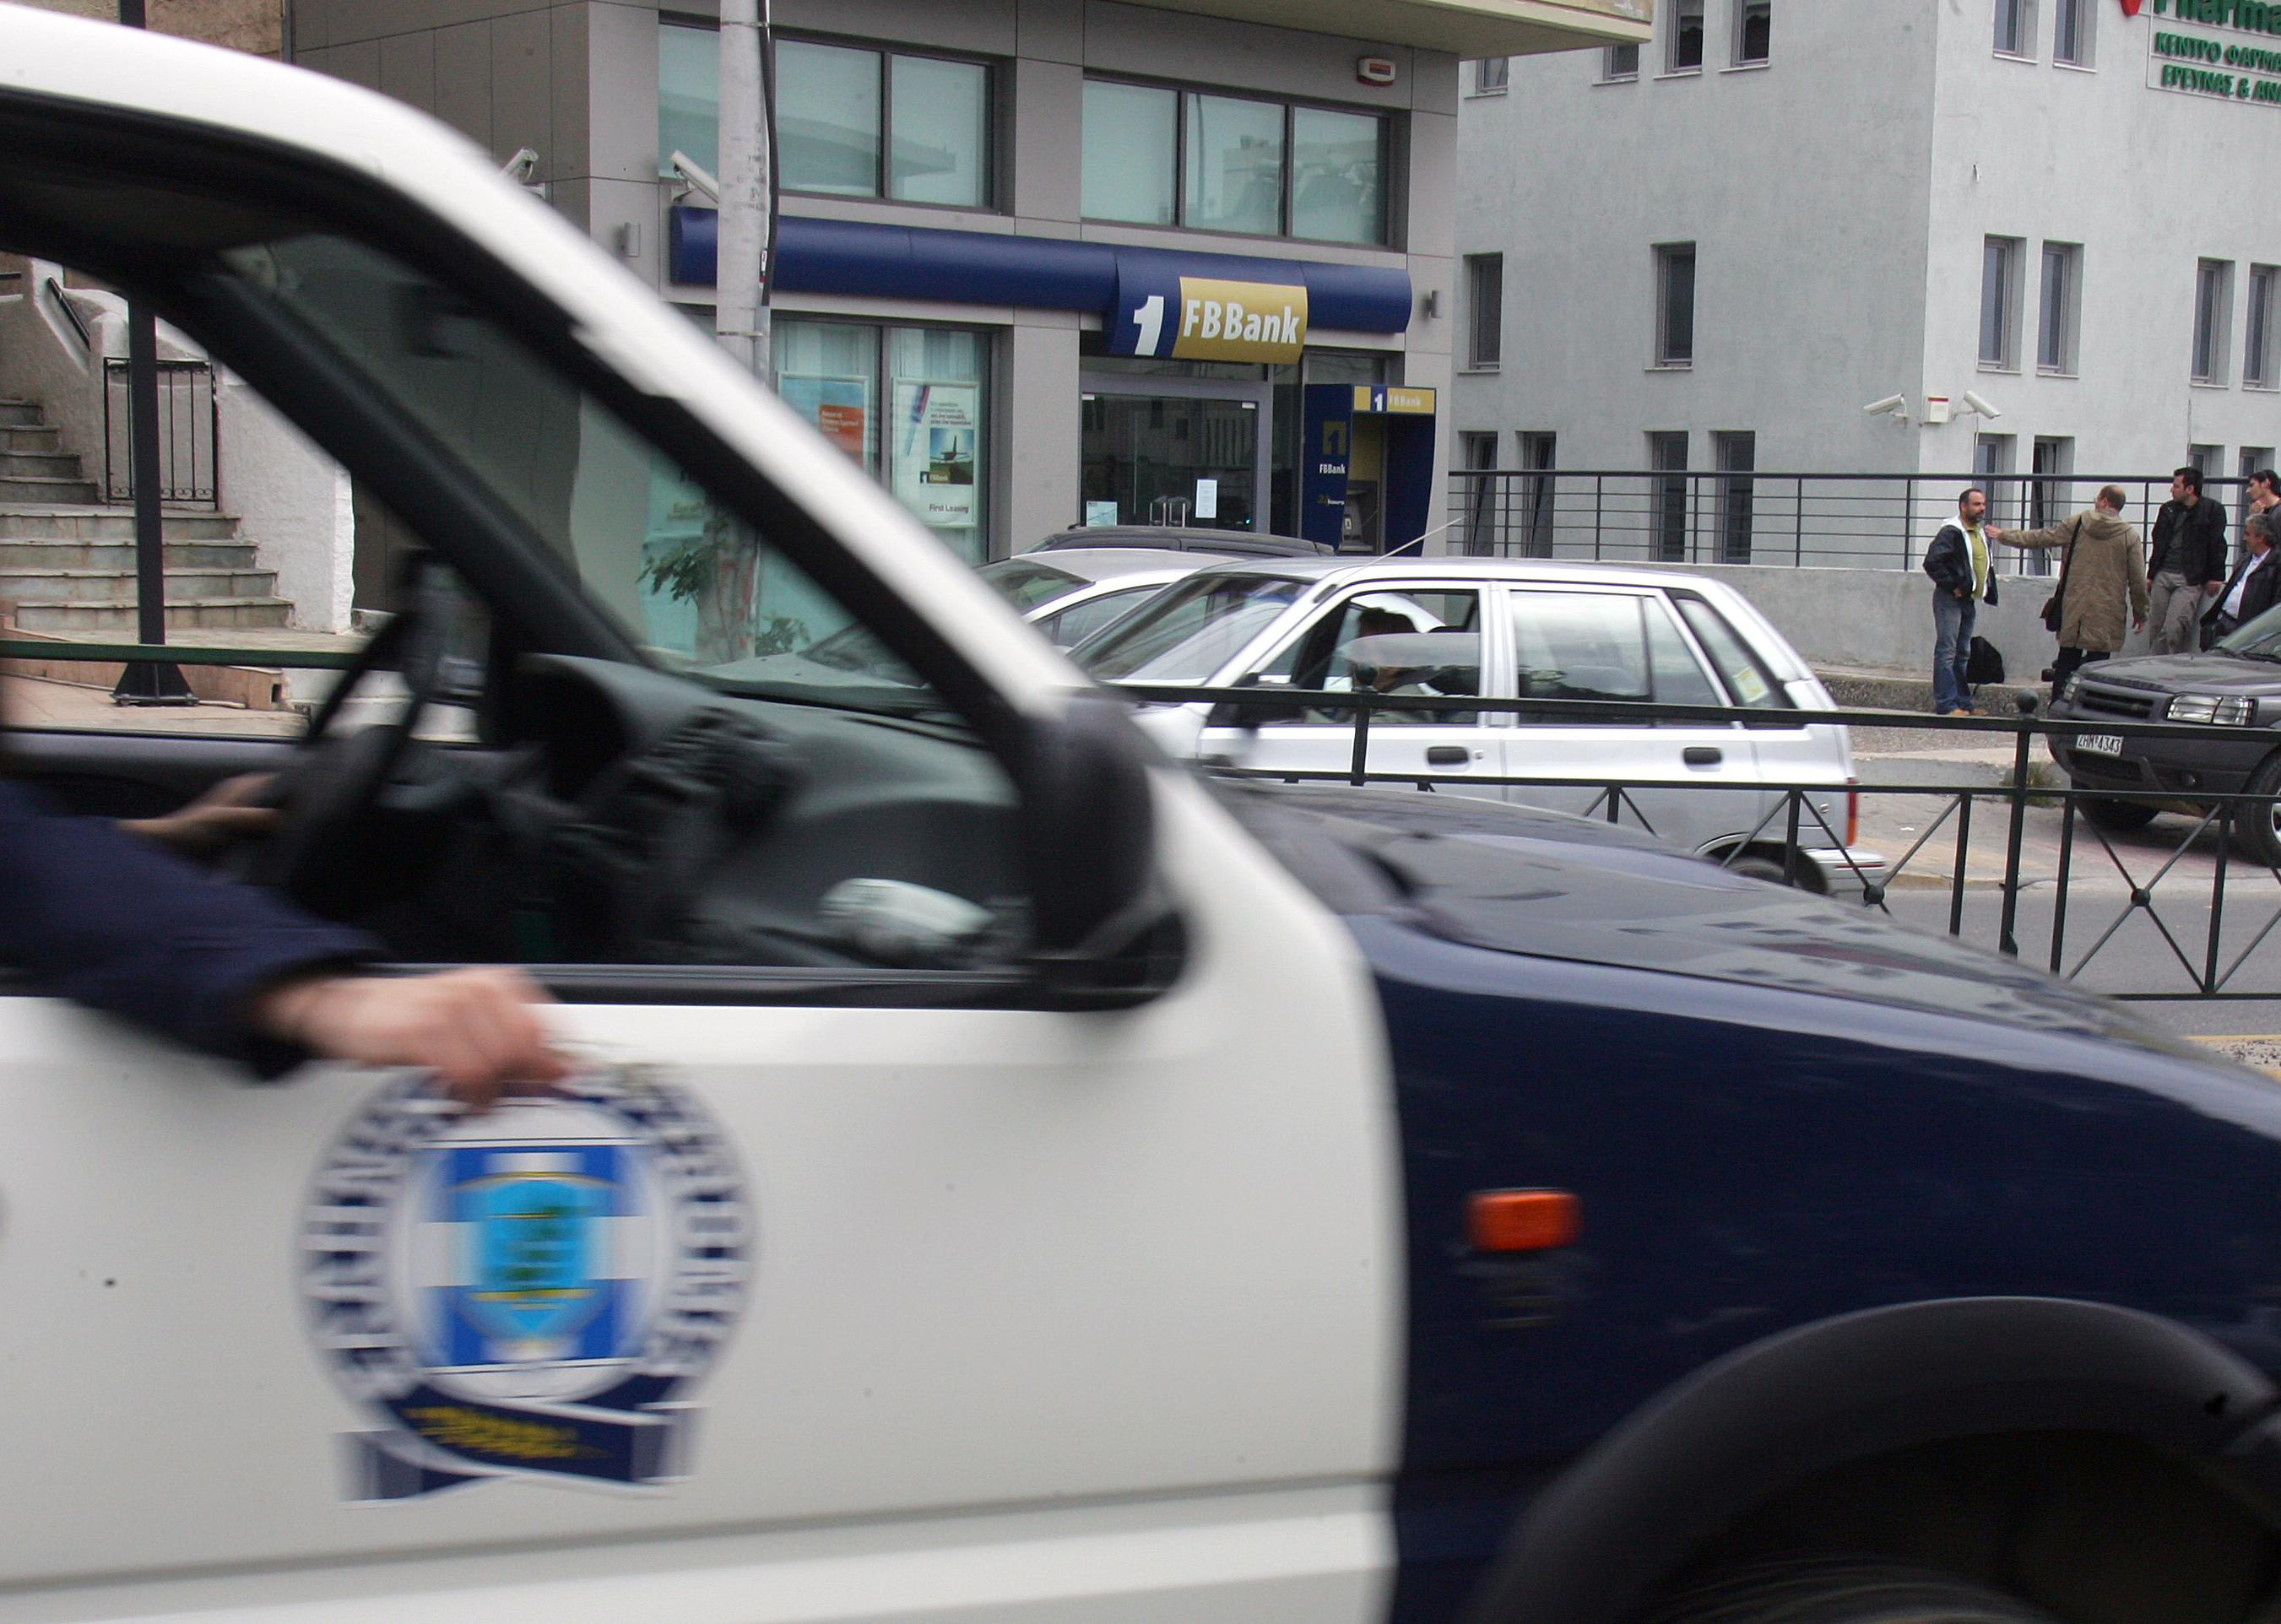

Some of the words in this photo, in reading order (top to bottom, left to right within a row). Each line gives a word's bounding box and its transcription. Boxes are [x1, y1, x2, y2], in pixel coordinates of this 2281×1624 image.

[2154, 0, 2281, 35] arma
[2154, 31, 2222, 62] ΚΕΝΤΡΟ
[2161, 64, 2235, 98] ΕΡΕΥΝΑΣ
[2236, 78, 2250, 99] &
[1133, 295, 1165, 356] 1
[1183, 298, 1301, 345] FBBank
[1374, 393, 1383, 412] 1
[1319, 463, 1346, 474] FBBank
